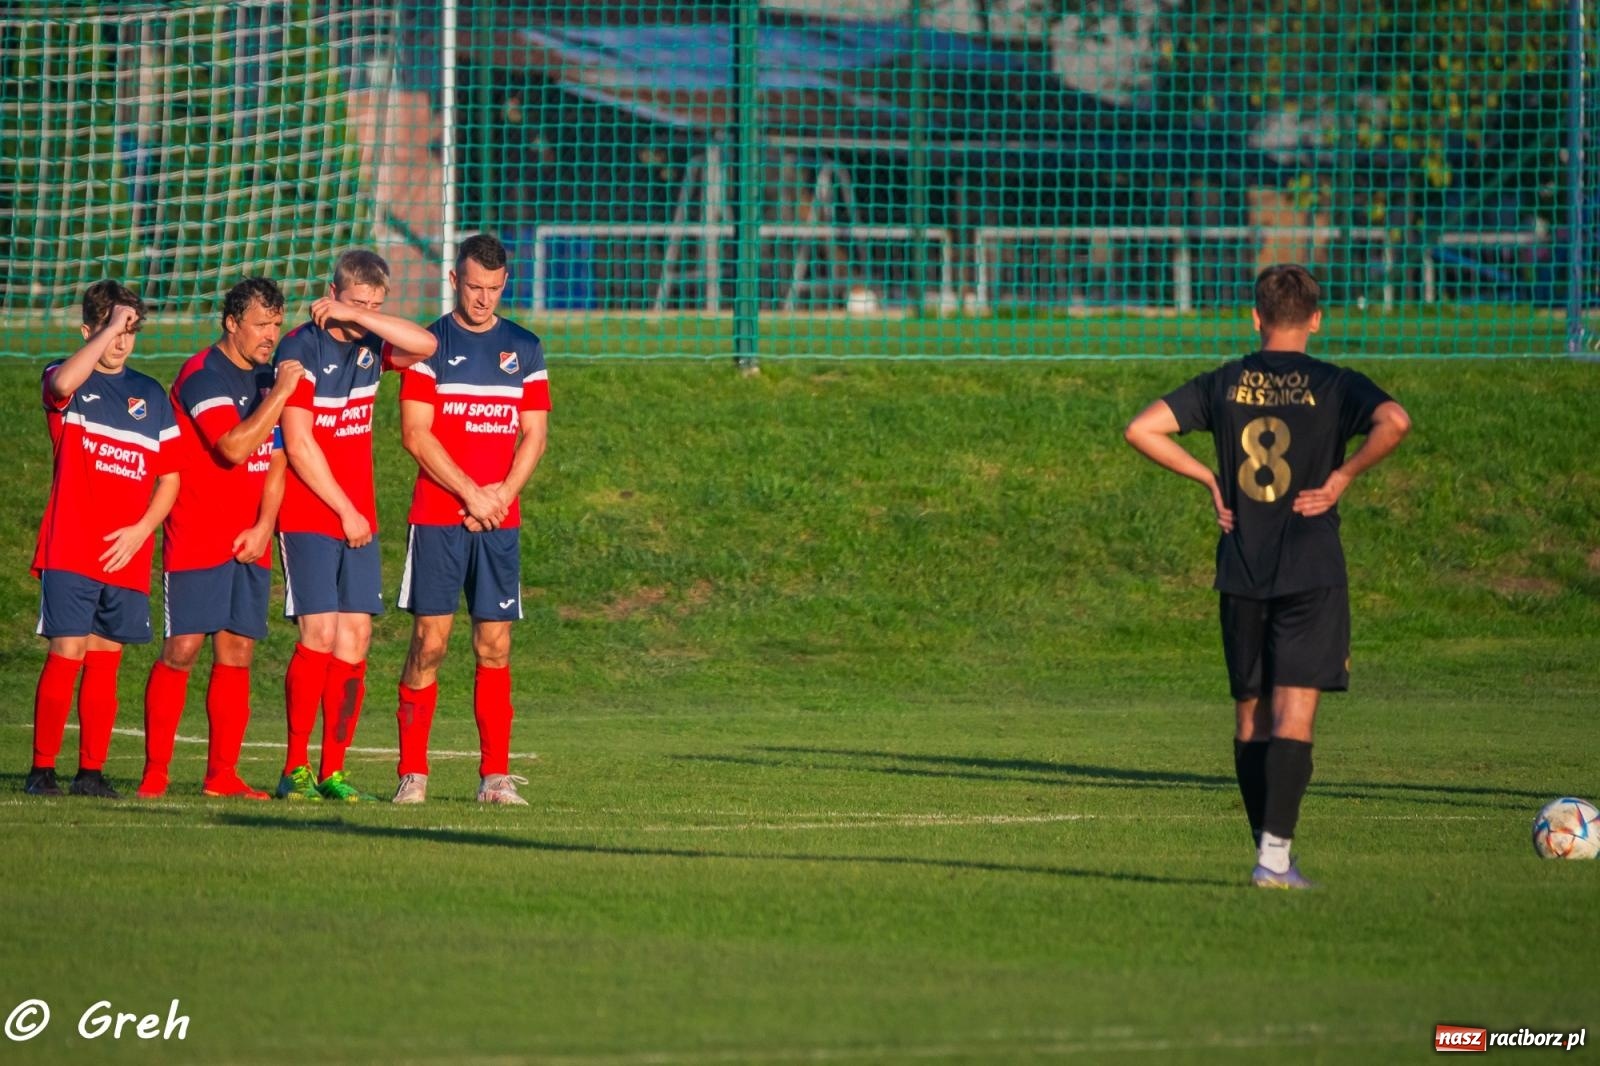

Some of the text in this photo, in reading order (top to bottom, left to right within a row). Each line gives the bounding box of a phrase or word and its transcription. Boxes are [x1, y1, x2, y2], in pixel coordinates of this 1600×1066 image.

[467, 403, 512, 418] SPORT
[98, 443, 139, 464] SPORT
[1238, 416, 1291, 502] 8
